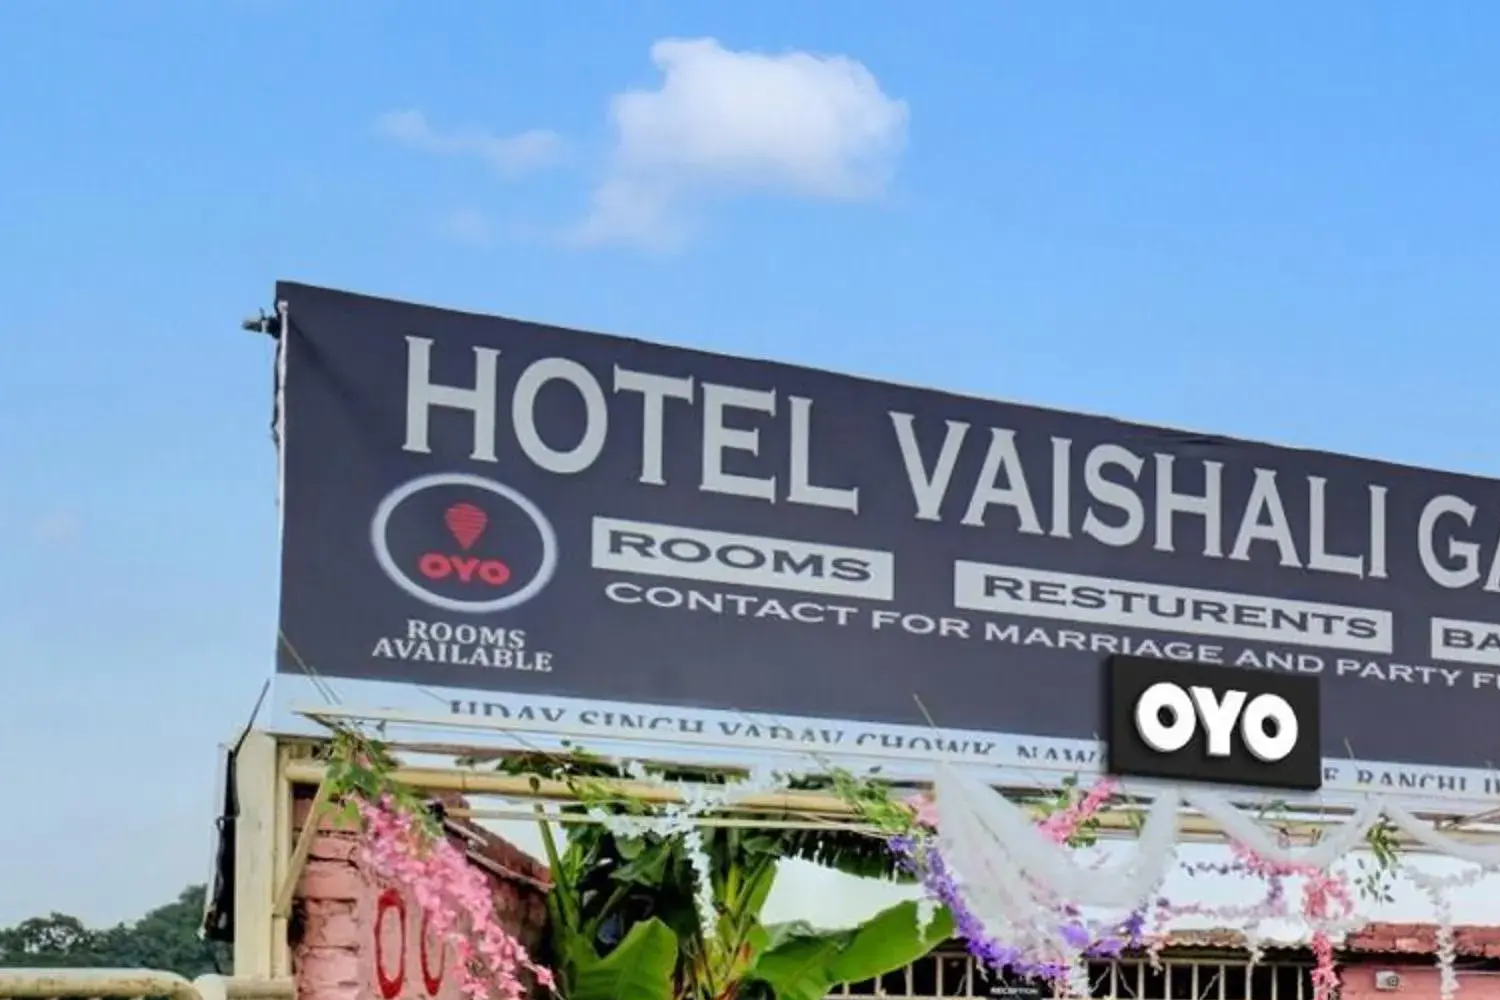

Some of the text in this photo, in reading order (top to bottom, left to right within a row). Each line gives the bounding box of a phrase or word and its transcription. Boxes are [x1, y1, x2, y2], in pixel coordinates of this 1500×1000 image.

[402, 335, 859, 514] HOTEL
[888, 411, 1388, 579] VAISHALI
[418, 552, 511, 585] OYO
[608, 529, 873, 582] ROOMS
[407, 618, 527, 649] ROOMS
[605, 582, 858, 626] CONTACT
[871, 610, 970, 639] FOR
[985, 624, 1223, 665] MARRIAGE
[1235, 649, 1325, 673] AND
[1336, 659, 1465, 687] PARTY
[983, 574, 1378, 639] RESTURENTS
[372, 637, 553, 672] AVAILABLE
[1135, 681, 1299, 763] OYO
